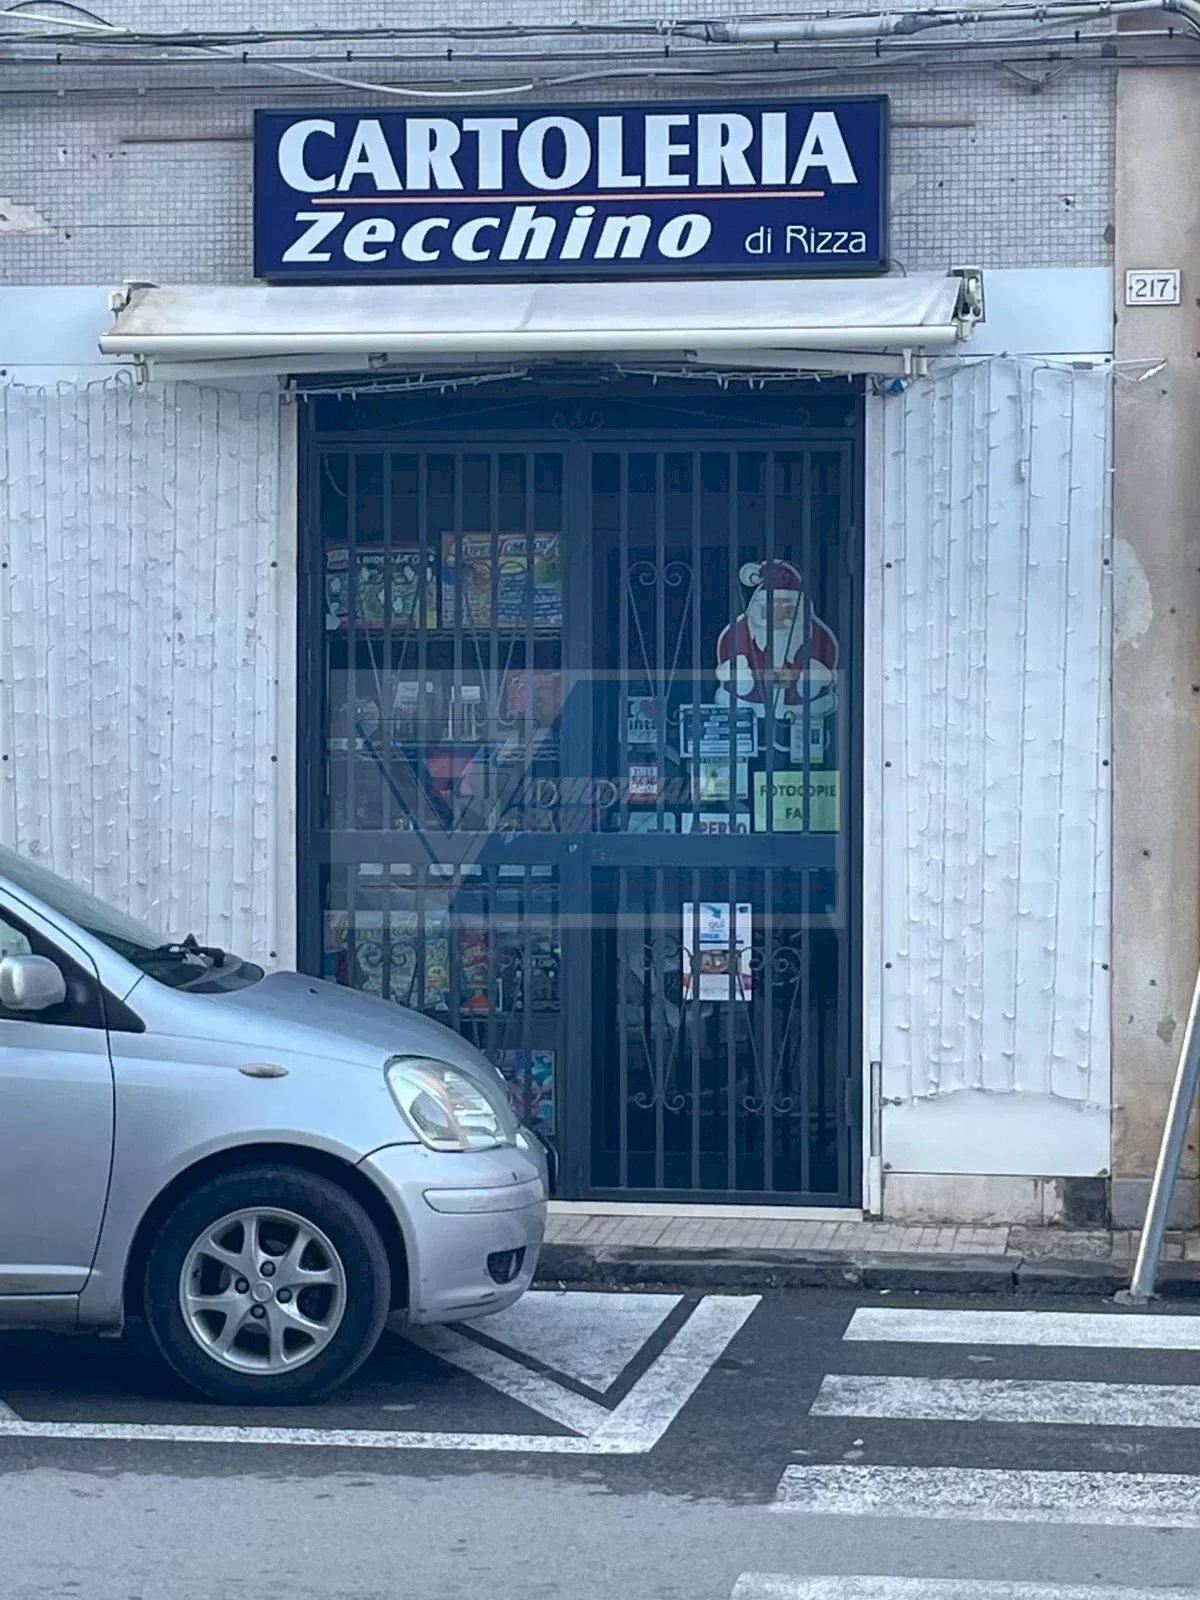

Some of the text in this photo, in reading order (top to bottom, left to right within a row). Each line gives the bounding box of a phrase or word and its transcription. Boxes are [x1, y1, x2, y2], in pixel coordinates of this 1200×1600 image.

[278, 111, 858, 193] CARTOLERIA
[282, 205, 712, 262] Zecchino
[745, 225, 866, 254] di Rizza
[1135, 278, 1170, 298] 217
[760, 785, 837, 797] FOTOCOPIE
